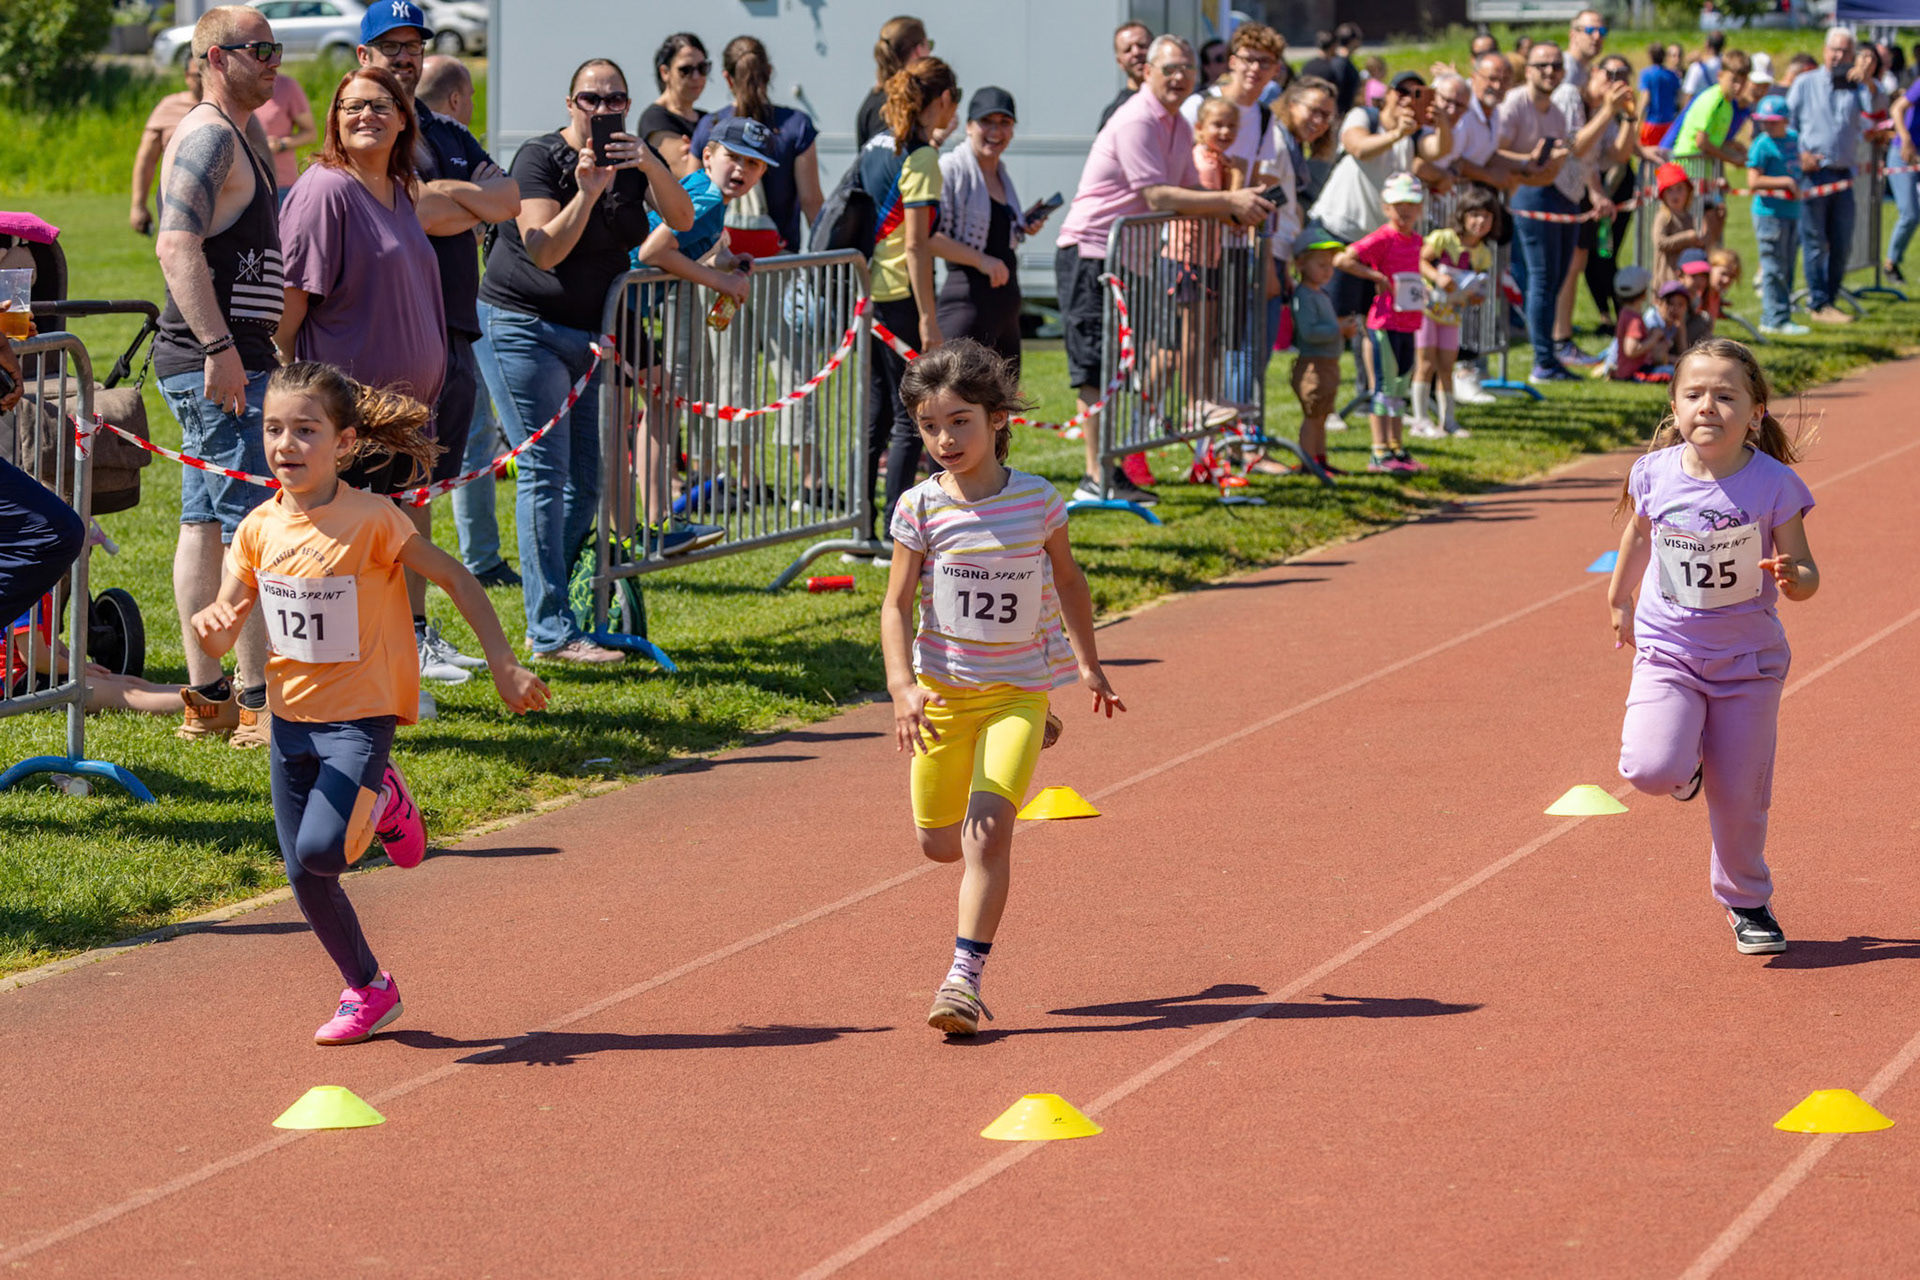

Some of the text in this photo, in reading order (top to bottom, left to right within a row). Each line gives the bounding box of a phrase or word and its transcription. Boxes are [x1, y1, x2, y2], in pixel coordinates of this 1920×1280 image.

[391, 1, 410, 18] NY
[1706, 537, 1752, 552] SPRINT
[990, 571, 1035, 581] SPRINT
[1680, 559, 1738, 589] 125
[298, 590, 347, 600] SPRINT
[958, 590, 1018, 624] 123
[277, 609, 324, 641] 121
